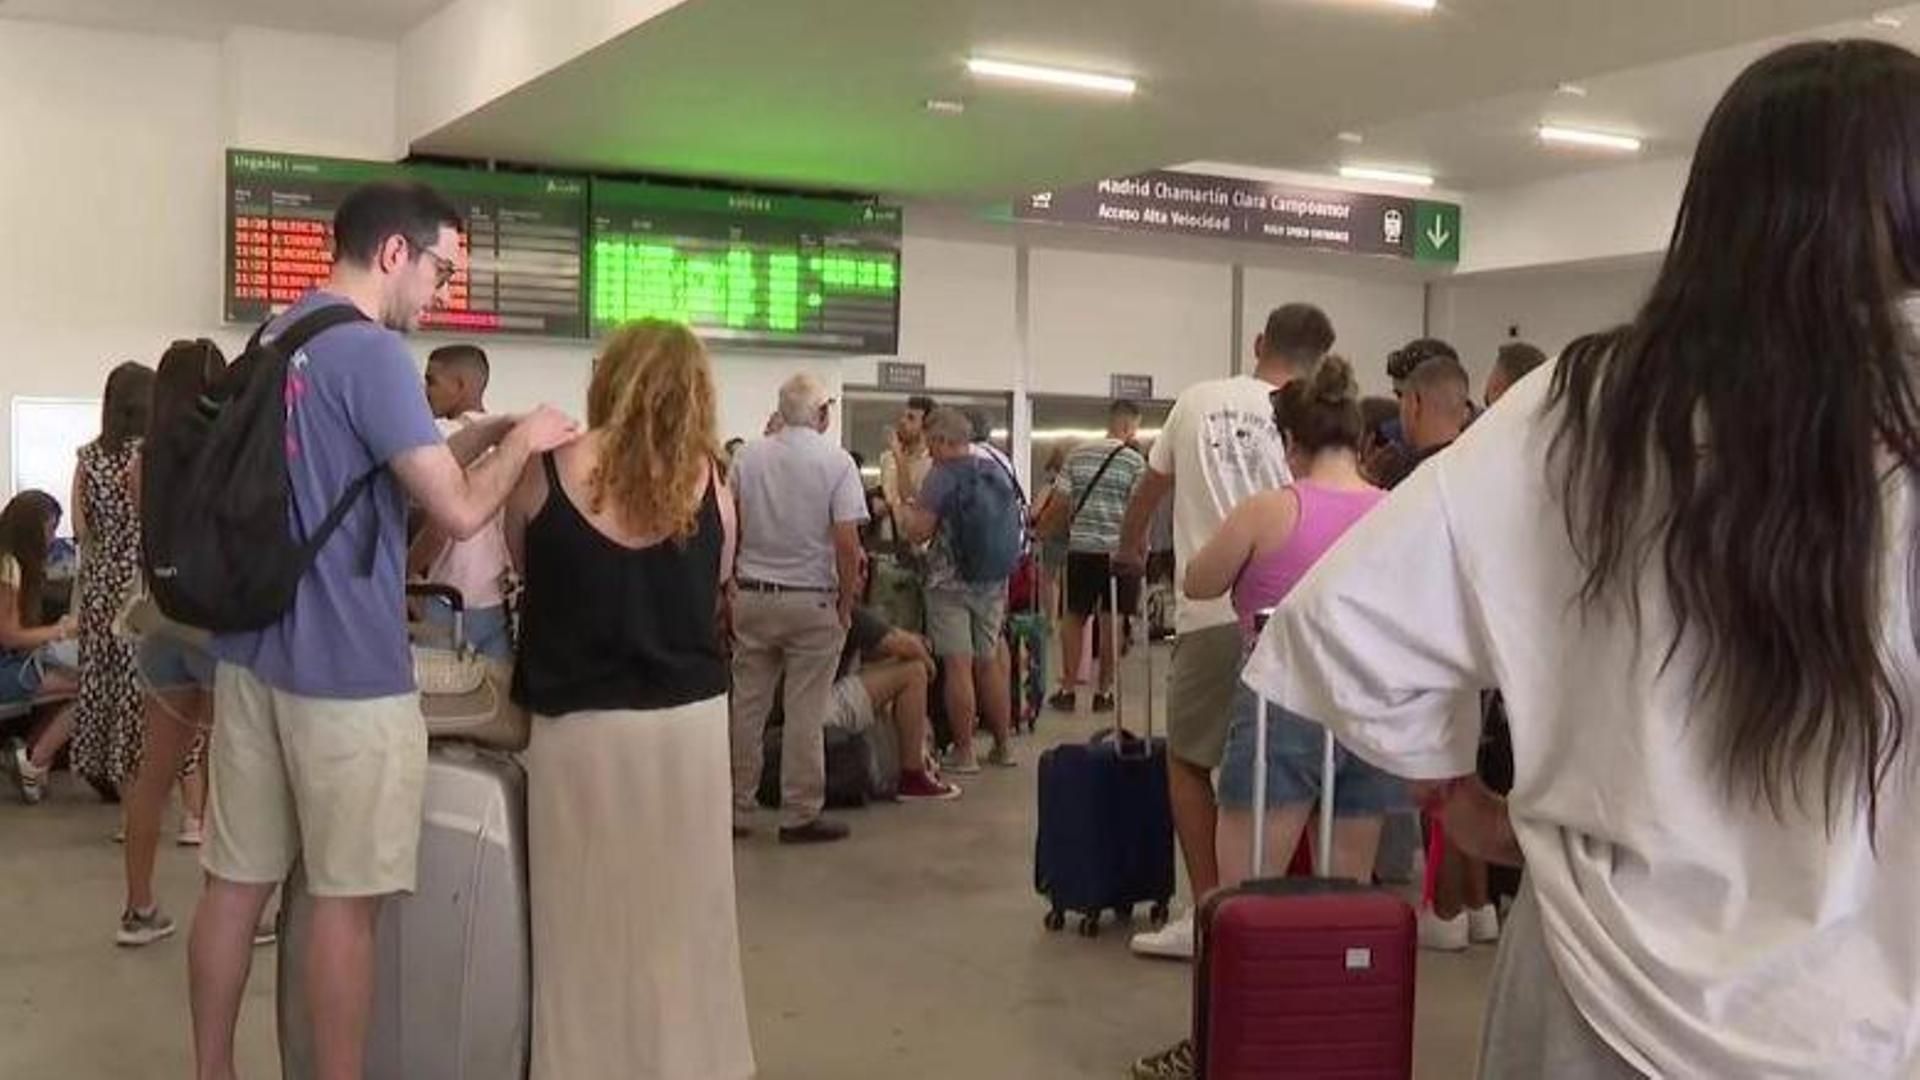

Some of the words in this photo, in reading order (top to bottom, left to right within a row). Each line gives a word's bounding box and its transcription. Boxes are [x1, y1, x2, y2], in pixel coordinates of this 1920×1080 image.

[1098, 177, 1150, 197] Madrid
[1155, 180, 1229, 206] Chamartín
[1232, 188, 1266, 209] Clara
[1271, 194, 1350, 219] Campoamor
[1099, 202, 1140, 221] Acceso
[1143, 207, 1168, 224] Alta
[1170, 210, 1231, 232] Velocidad
